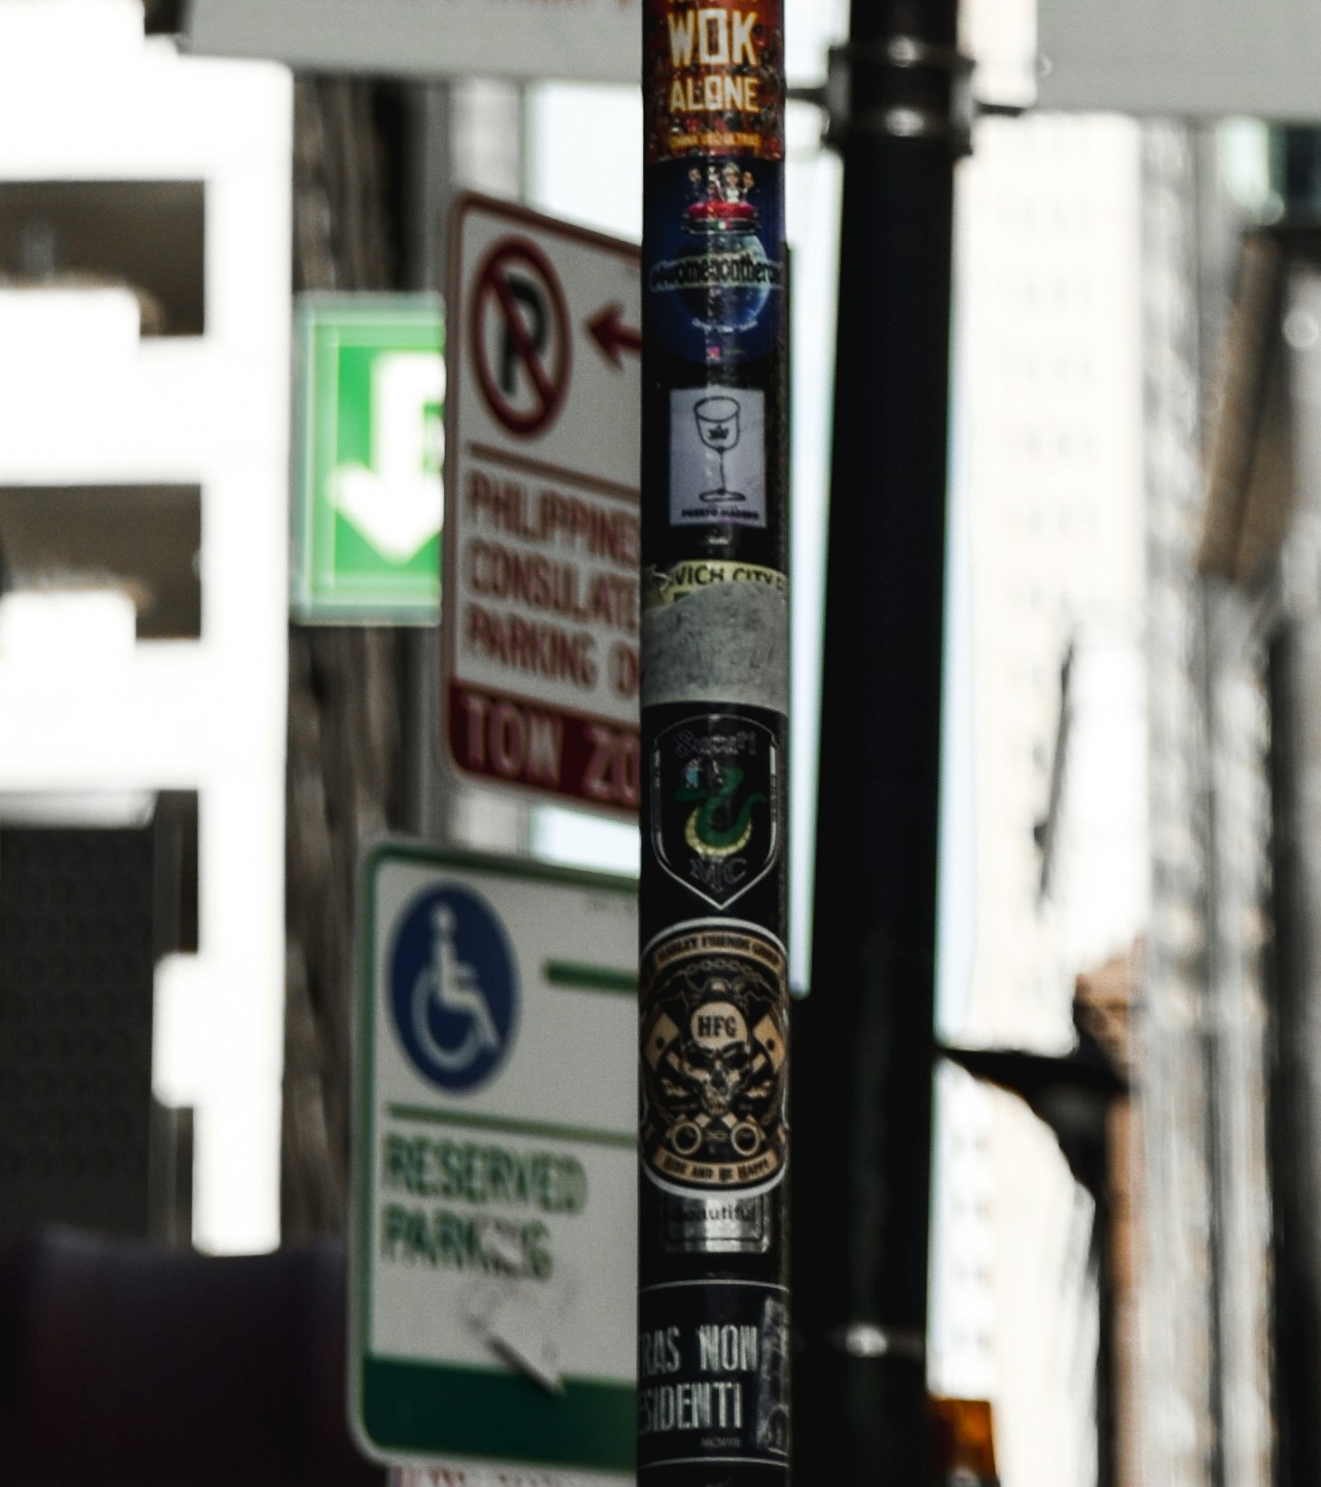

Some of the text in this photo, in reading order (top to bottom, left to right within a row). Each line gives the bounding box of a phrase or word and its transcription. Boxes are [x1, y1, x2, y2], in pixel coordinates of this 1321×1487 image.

[667, 8, 759, 68] WOK
[669, 74, 760, 113] ALONE
[466, 601, 599, 693] PARKING
[464, 694, 566, 790] TOW
[386, 1134, 588, 1218] RESERVED
[697, 1324, 759, 1372] NON
